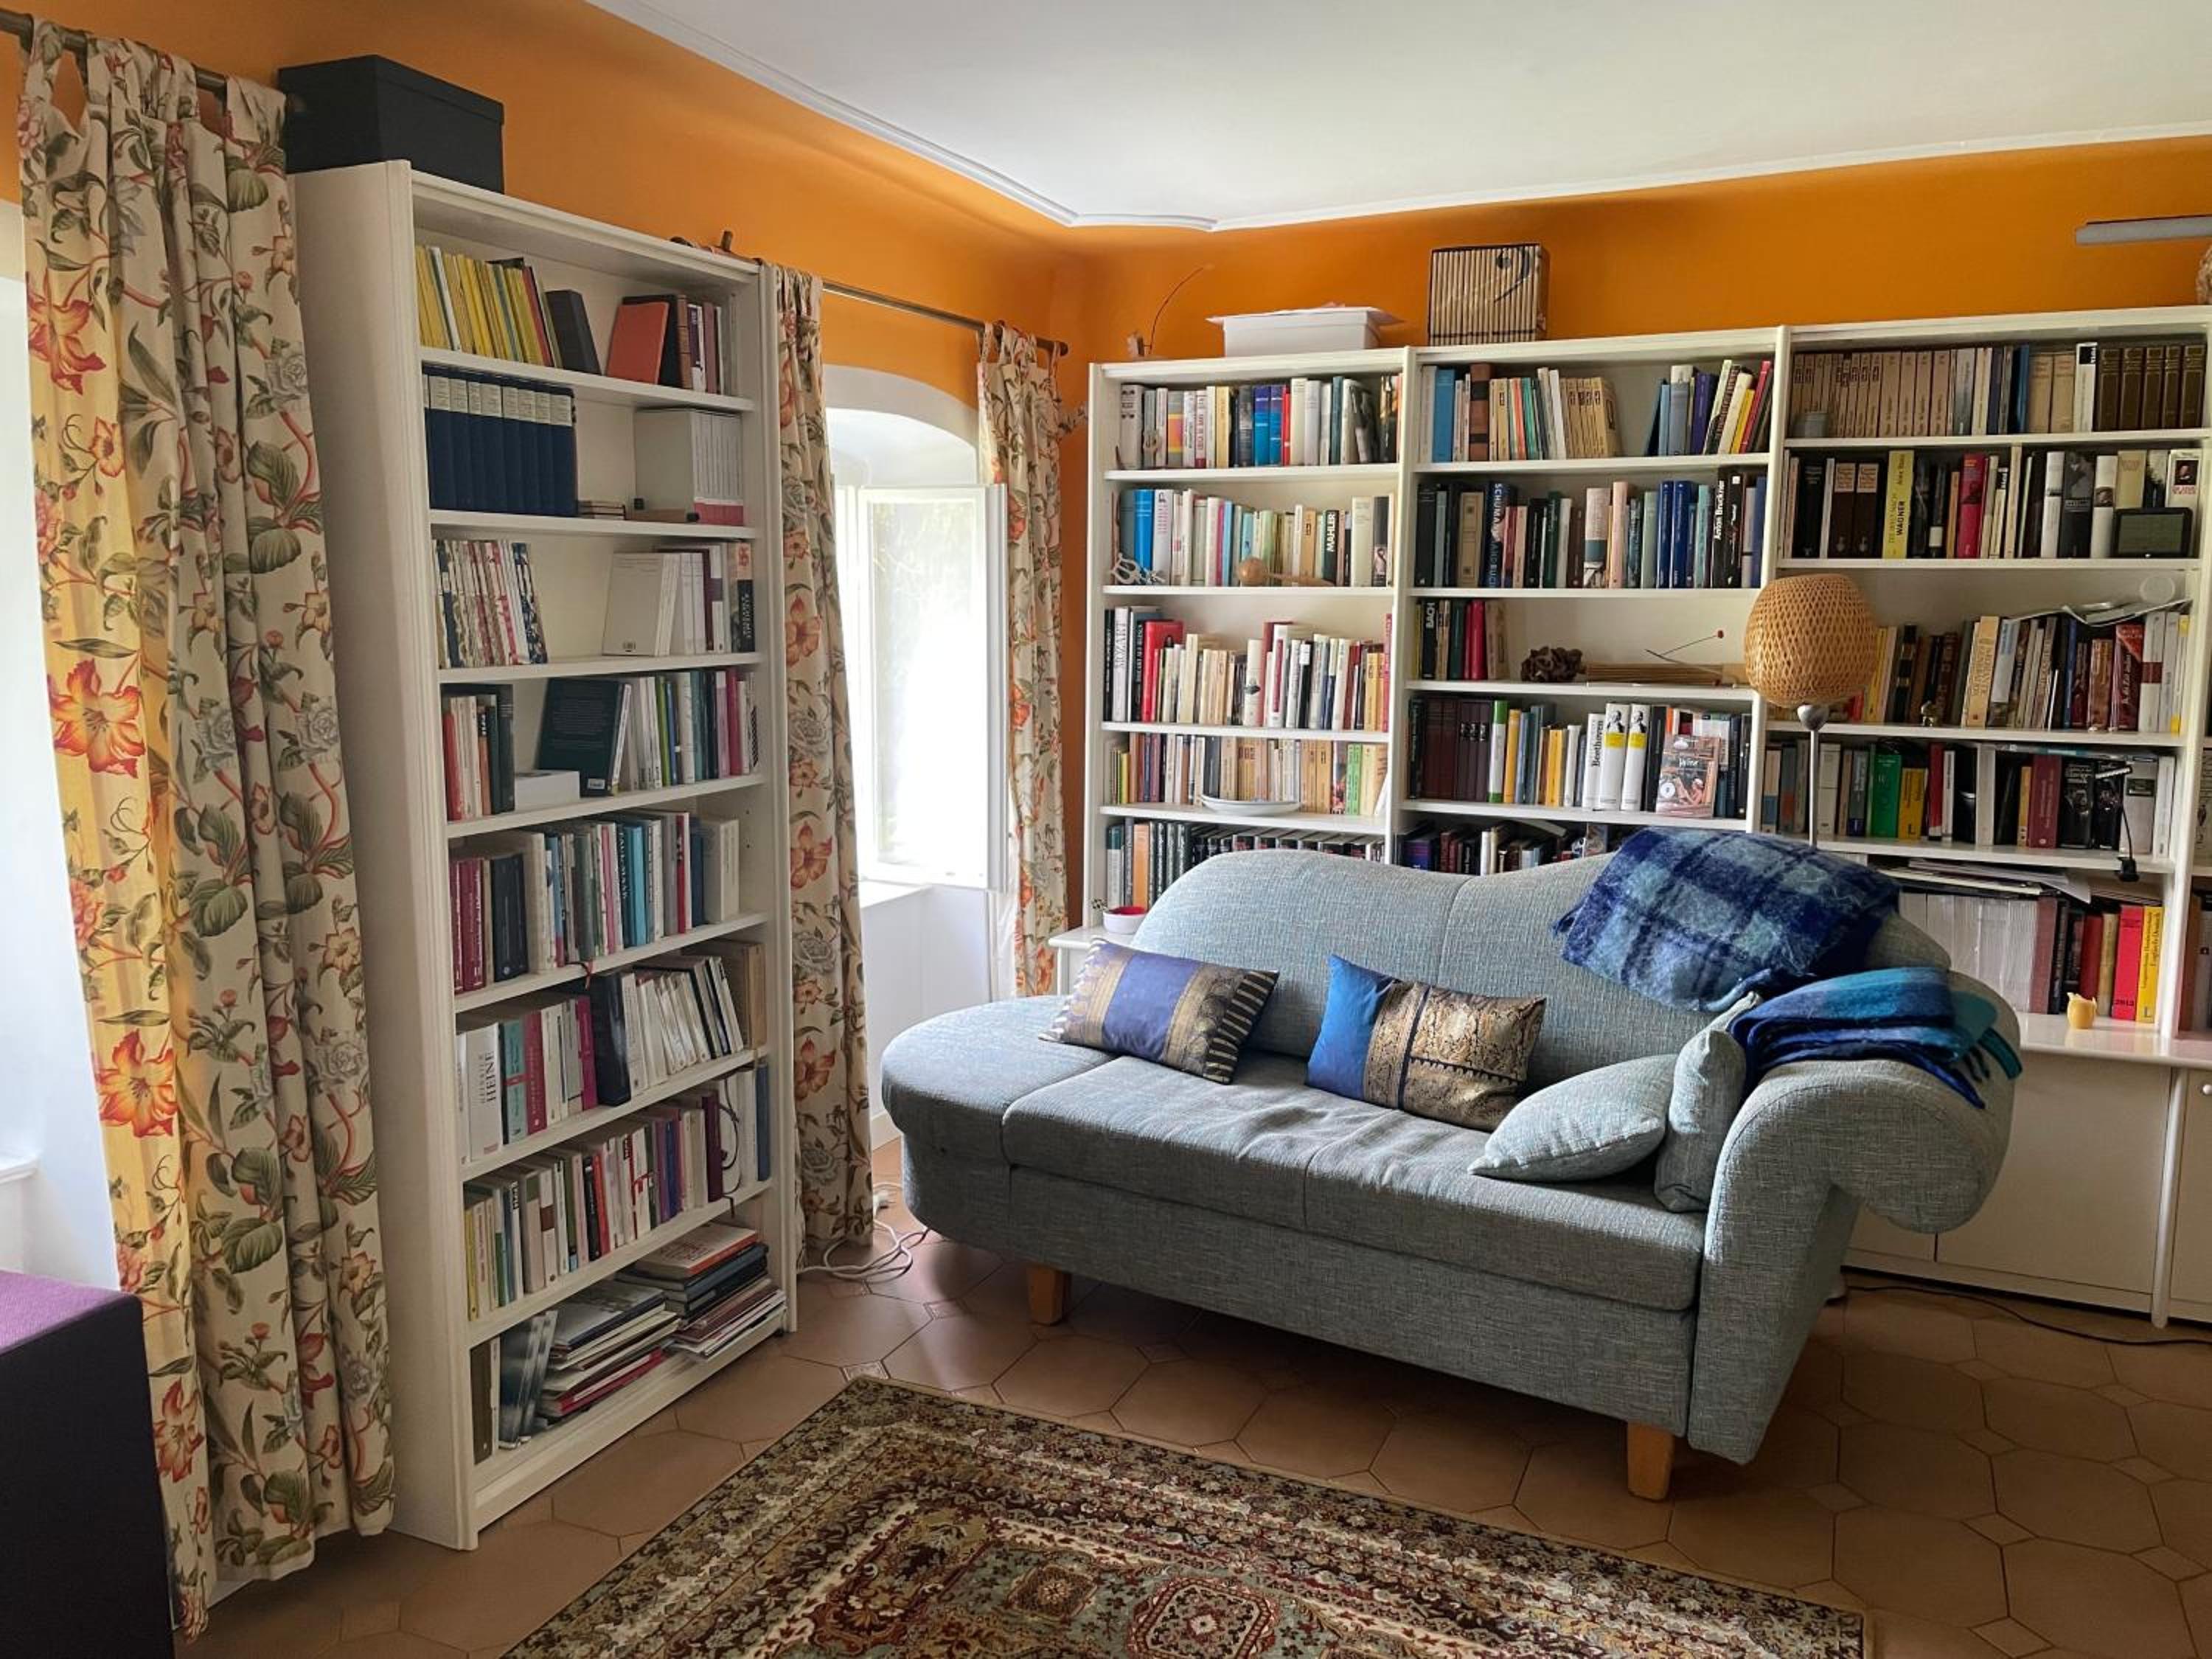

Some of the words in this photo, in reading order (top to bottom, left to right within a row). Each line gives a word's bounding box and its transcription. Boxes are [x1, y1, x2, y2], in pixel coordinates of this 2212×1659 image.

[1714, 480, 1725, 515] Bruckner
[1326, 513, 1335, 552] MAHLER
[1713, 516, 1723, 540] Anton
[1896, 501, 1905, 536] WAGNER
[1426, 602, 1436, 628] BACH
[1113, 622, 1127, 668] MOZART
[1591, 720, 1604, 768] Beethoven
[484, 1051, 496, 1102] HEINE
